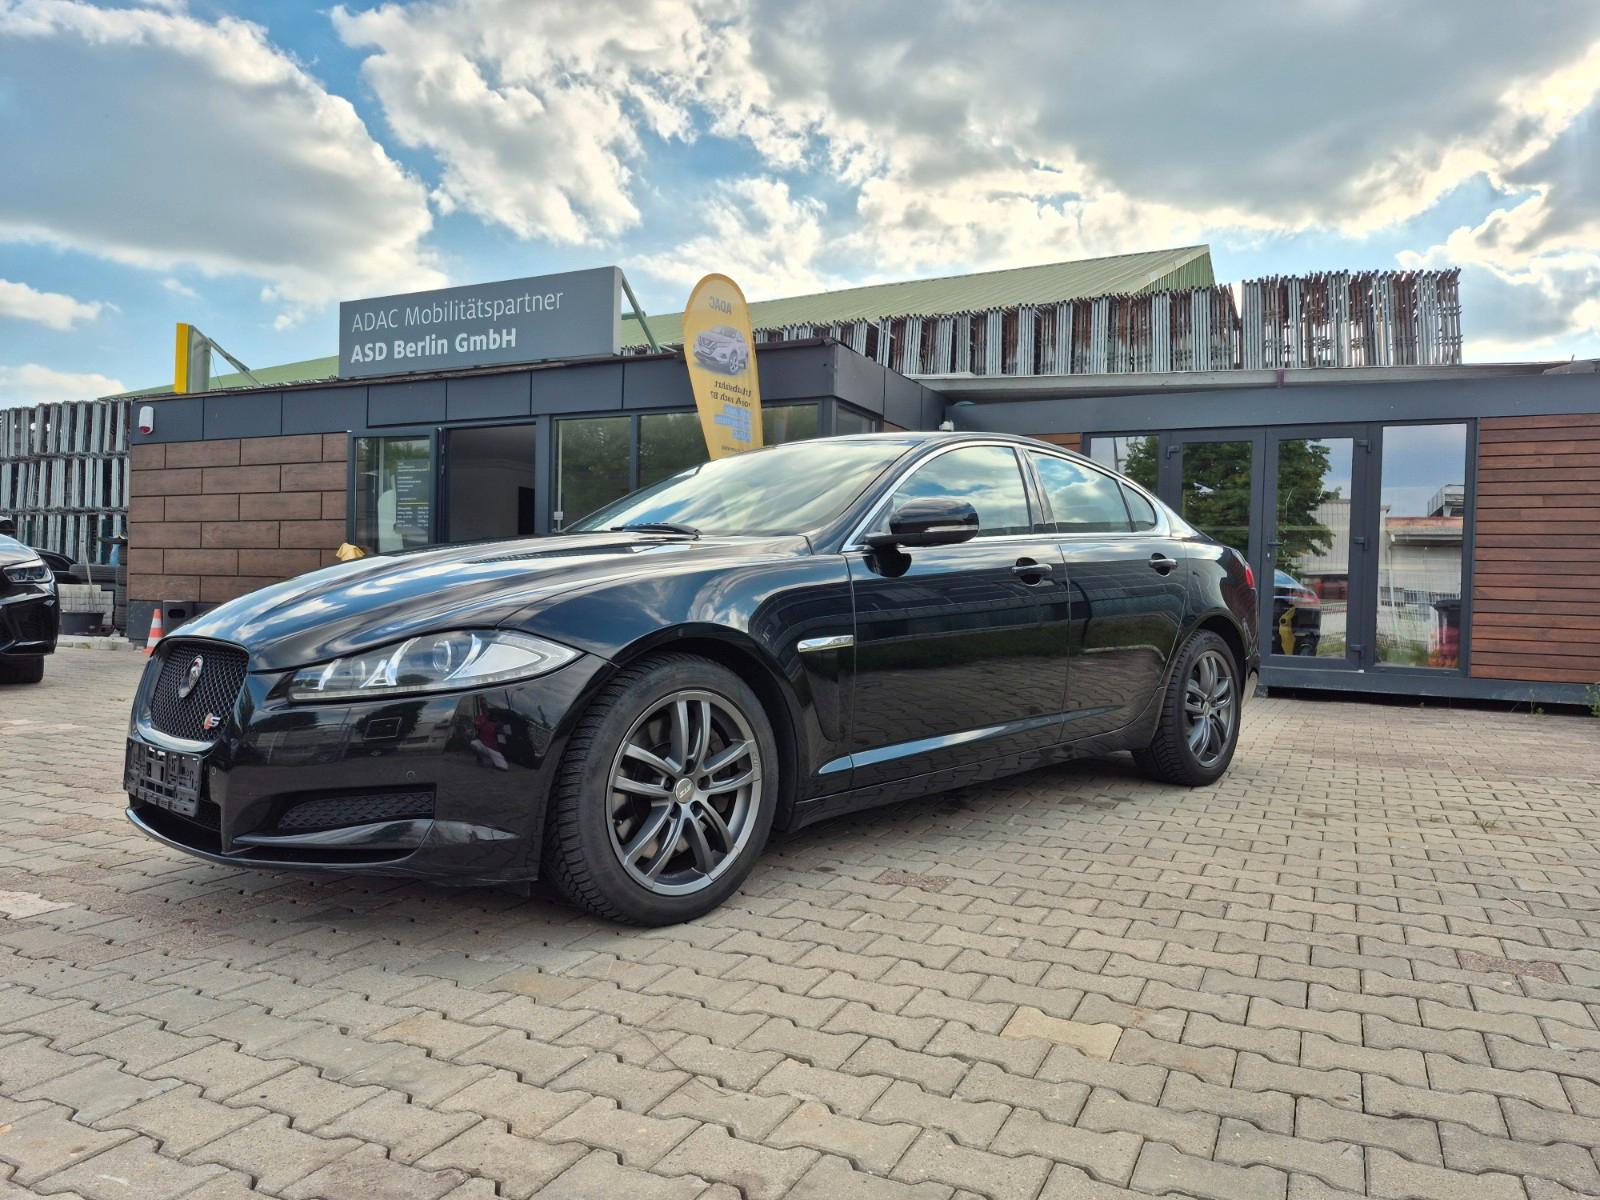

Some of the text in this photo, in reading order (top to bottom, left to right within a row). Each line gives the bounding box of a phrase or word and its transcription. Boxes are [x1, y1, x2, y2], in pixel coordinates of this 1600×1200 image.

[352, 292, 564, 333] ADAC Mobilitätspartner
[351, 328, 517, 364] ASD Berlin GmbH
